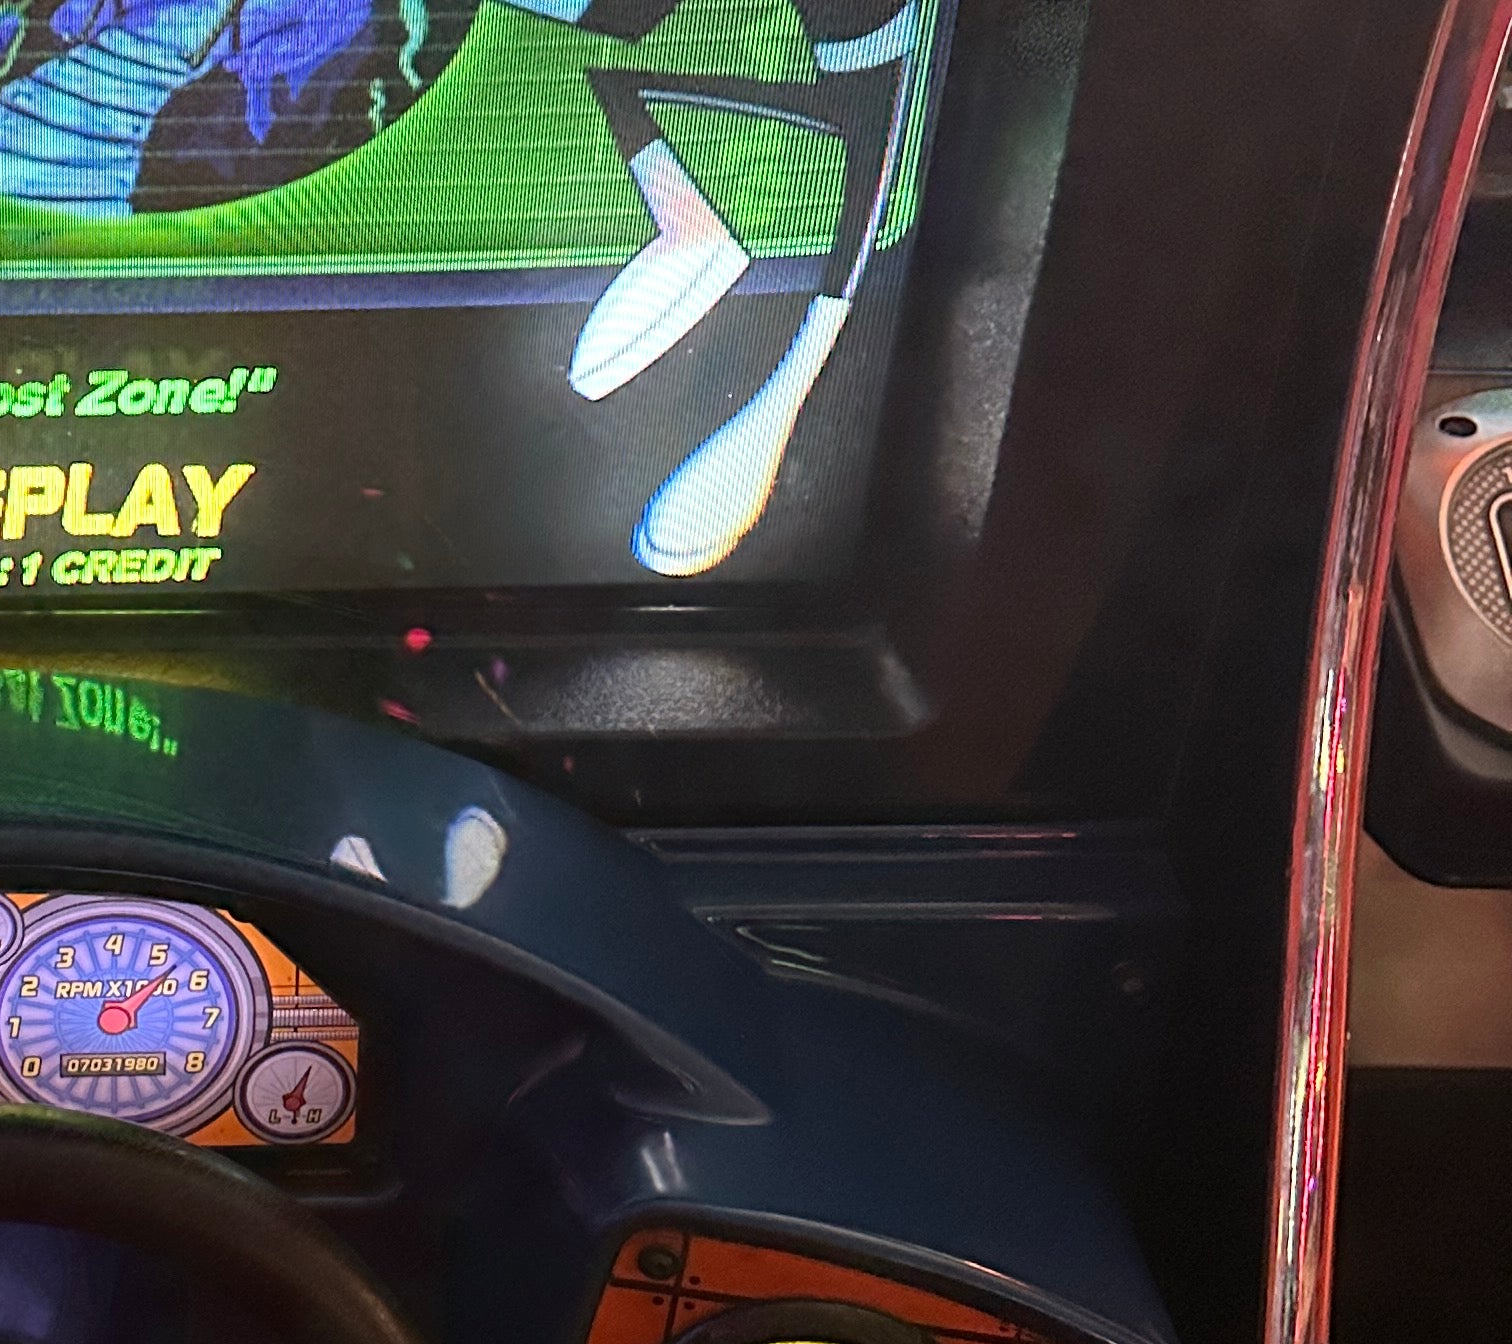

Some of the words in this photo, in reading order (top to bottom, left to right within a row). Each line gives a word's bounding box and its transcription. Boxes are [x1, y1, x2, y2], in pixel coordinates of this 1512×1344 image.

[74, 365, 279, 417] Zone!"
[21, 552, 43, 586] 1
[50, 546, 223, 585] CREDIT
[104, 932, 126, 955] 4
[148, 943, 169, 967] 5
[55, 947, 76, 969] 3
[20, 974, 40, 997] 2
[55, 979, 104, 999] RPM
[188, 969, 210, 992] 6
[7, 1016, 21, 1039] 1
[202, 1006, 223, 1030] 7
[21, 1055, 42, 1077] 0
[66, 1056, 160, 1074] 07031980
[185, 1051, 206, 1074] 8
